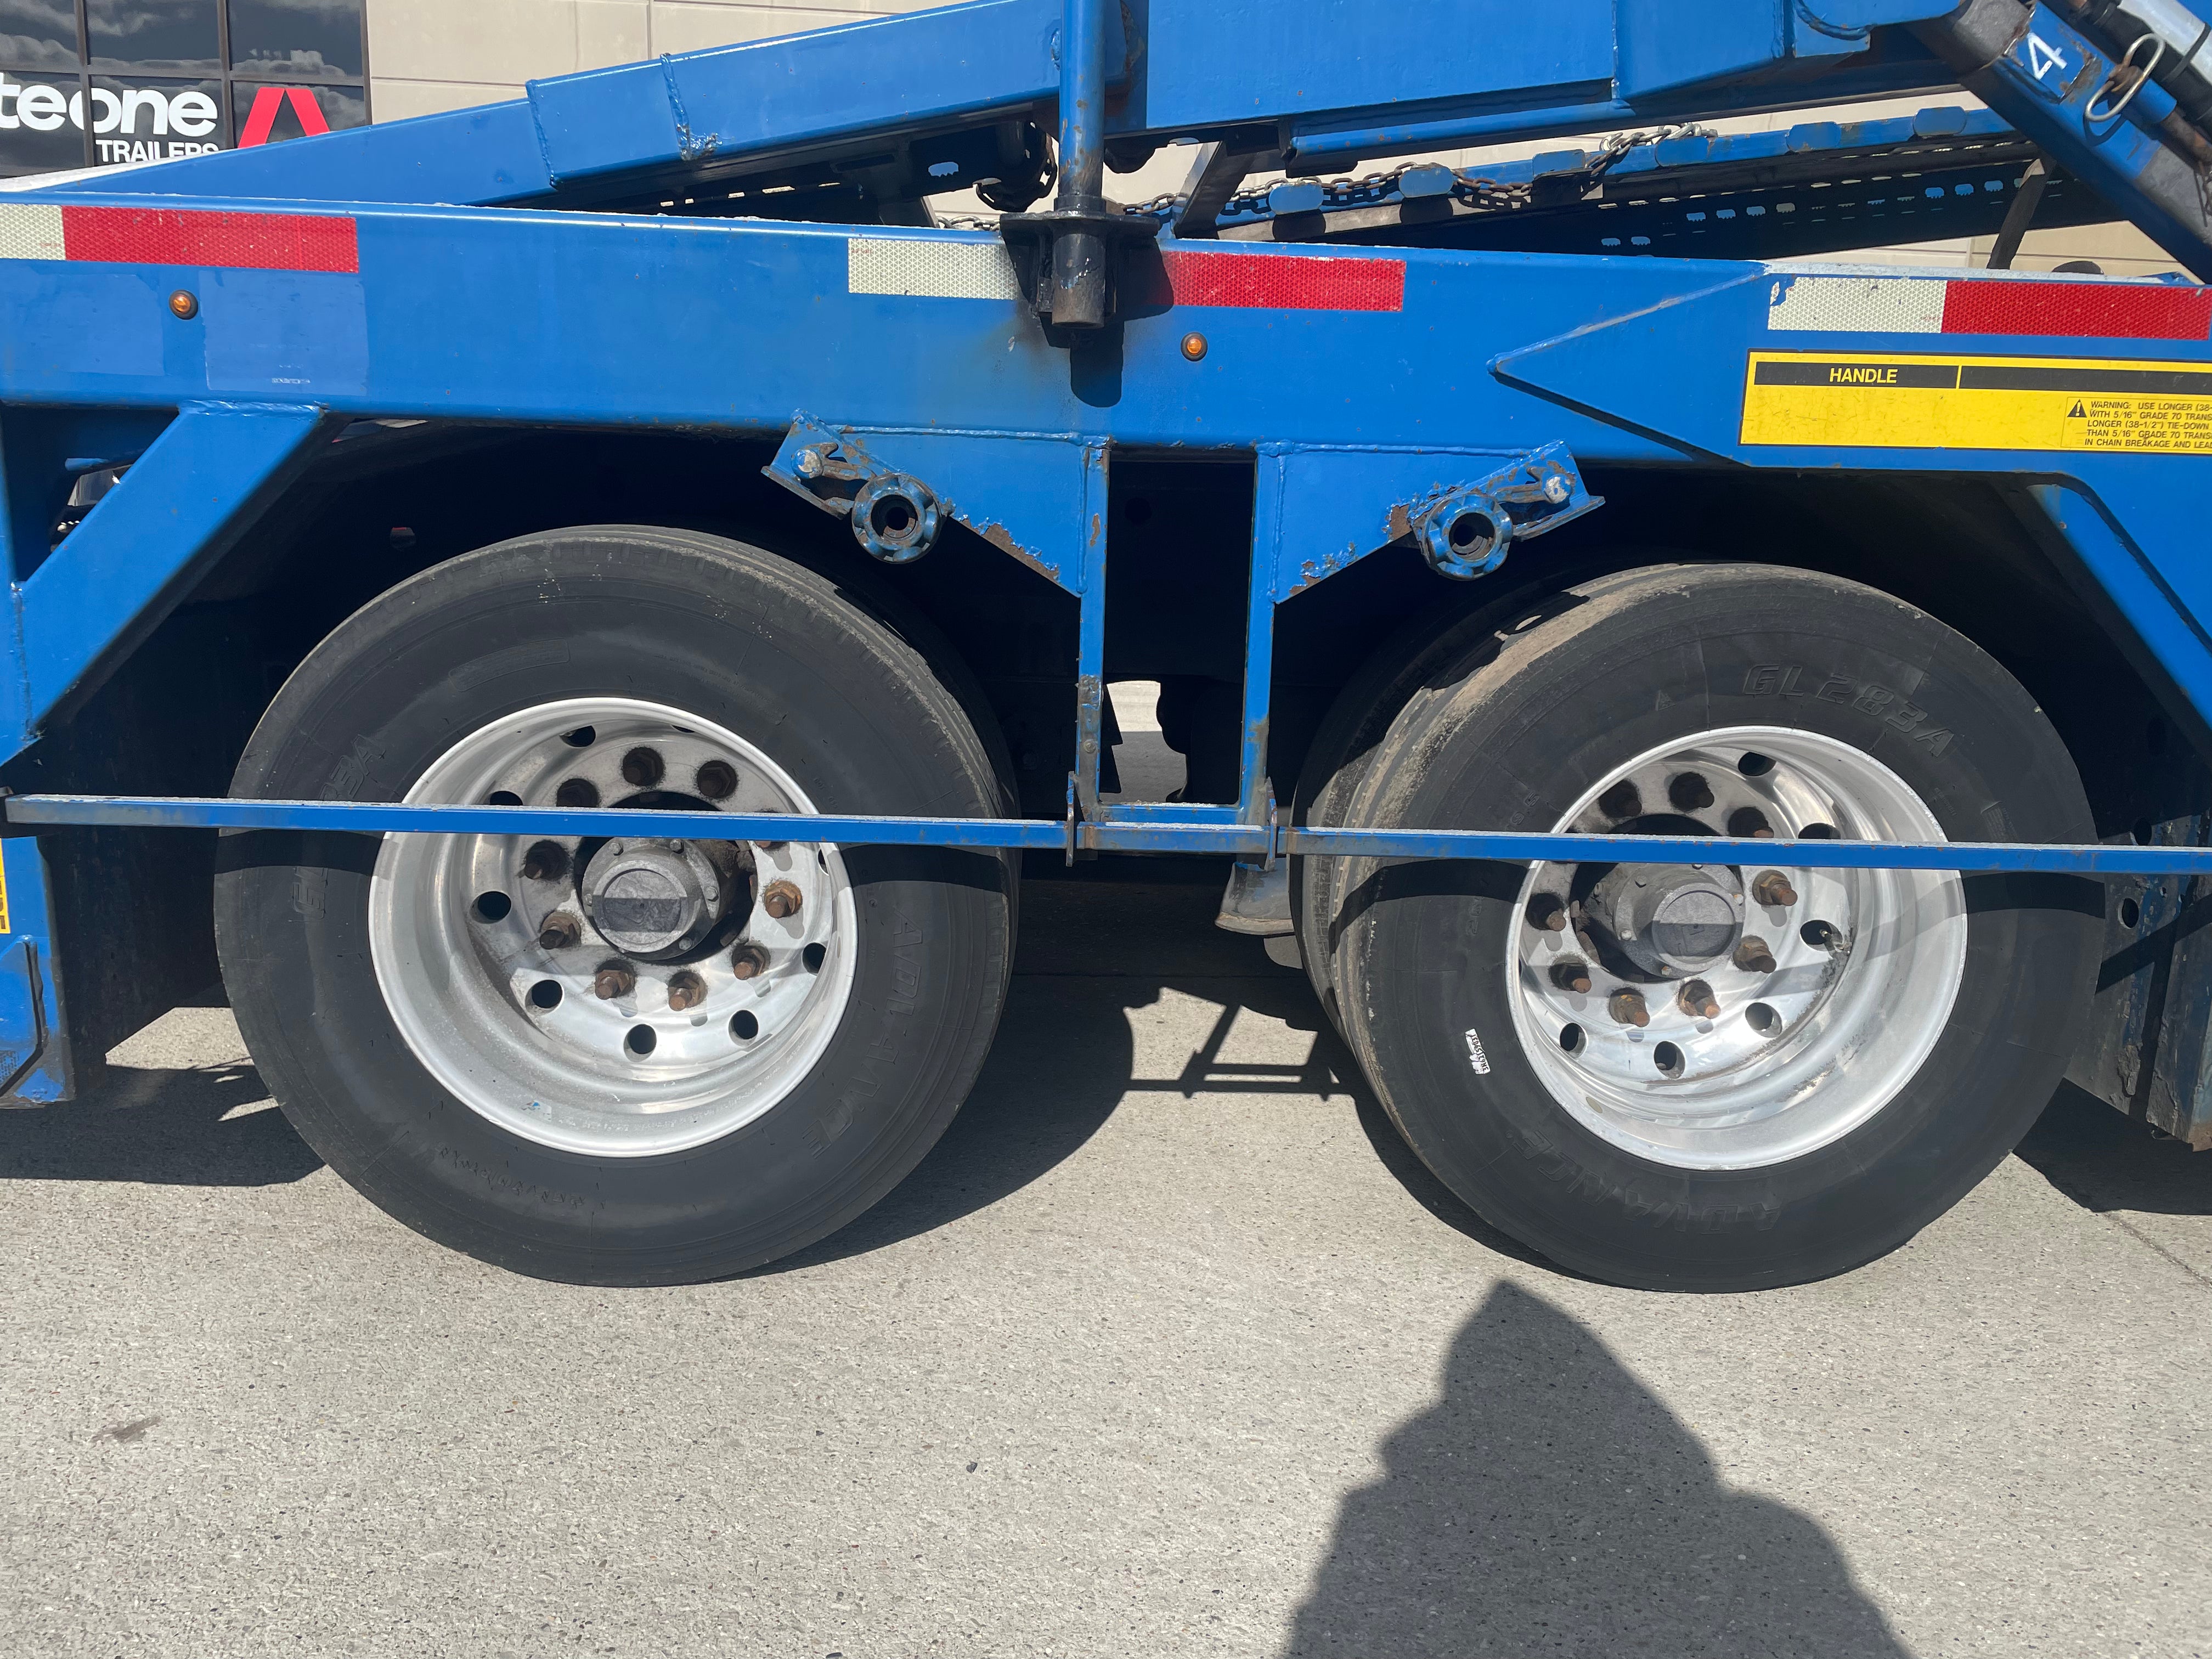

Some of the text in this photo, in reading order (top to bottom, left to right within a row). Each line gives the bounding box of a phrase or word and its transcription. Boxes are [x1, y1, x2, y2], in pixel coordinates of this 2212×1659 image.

[2027, 32, 2068, 80] 4
[1829, 368, 1898, 383] HANDLE
[2087, 420, 2121, 428] LONGER
[2168, 421, 2209, 430] TIE-DOWN
[2125, 439, 2170, 448] BREAKAGE
[1743, 664, 1955, 758] GL 283A
